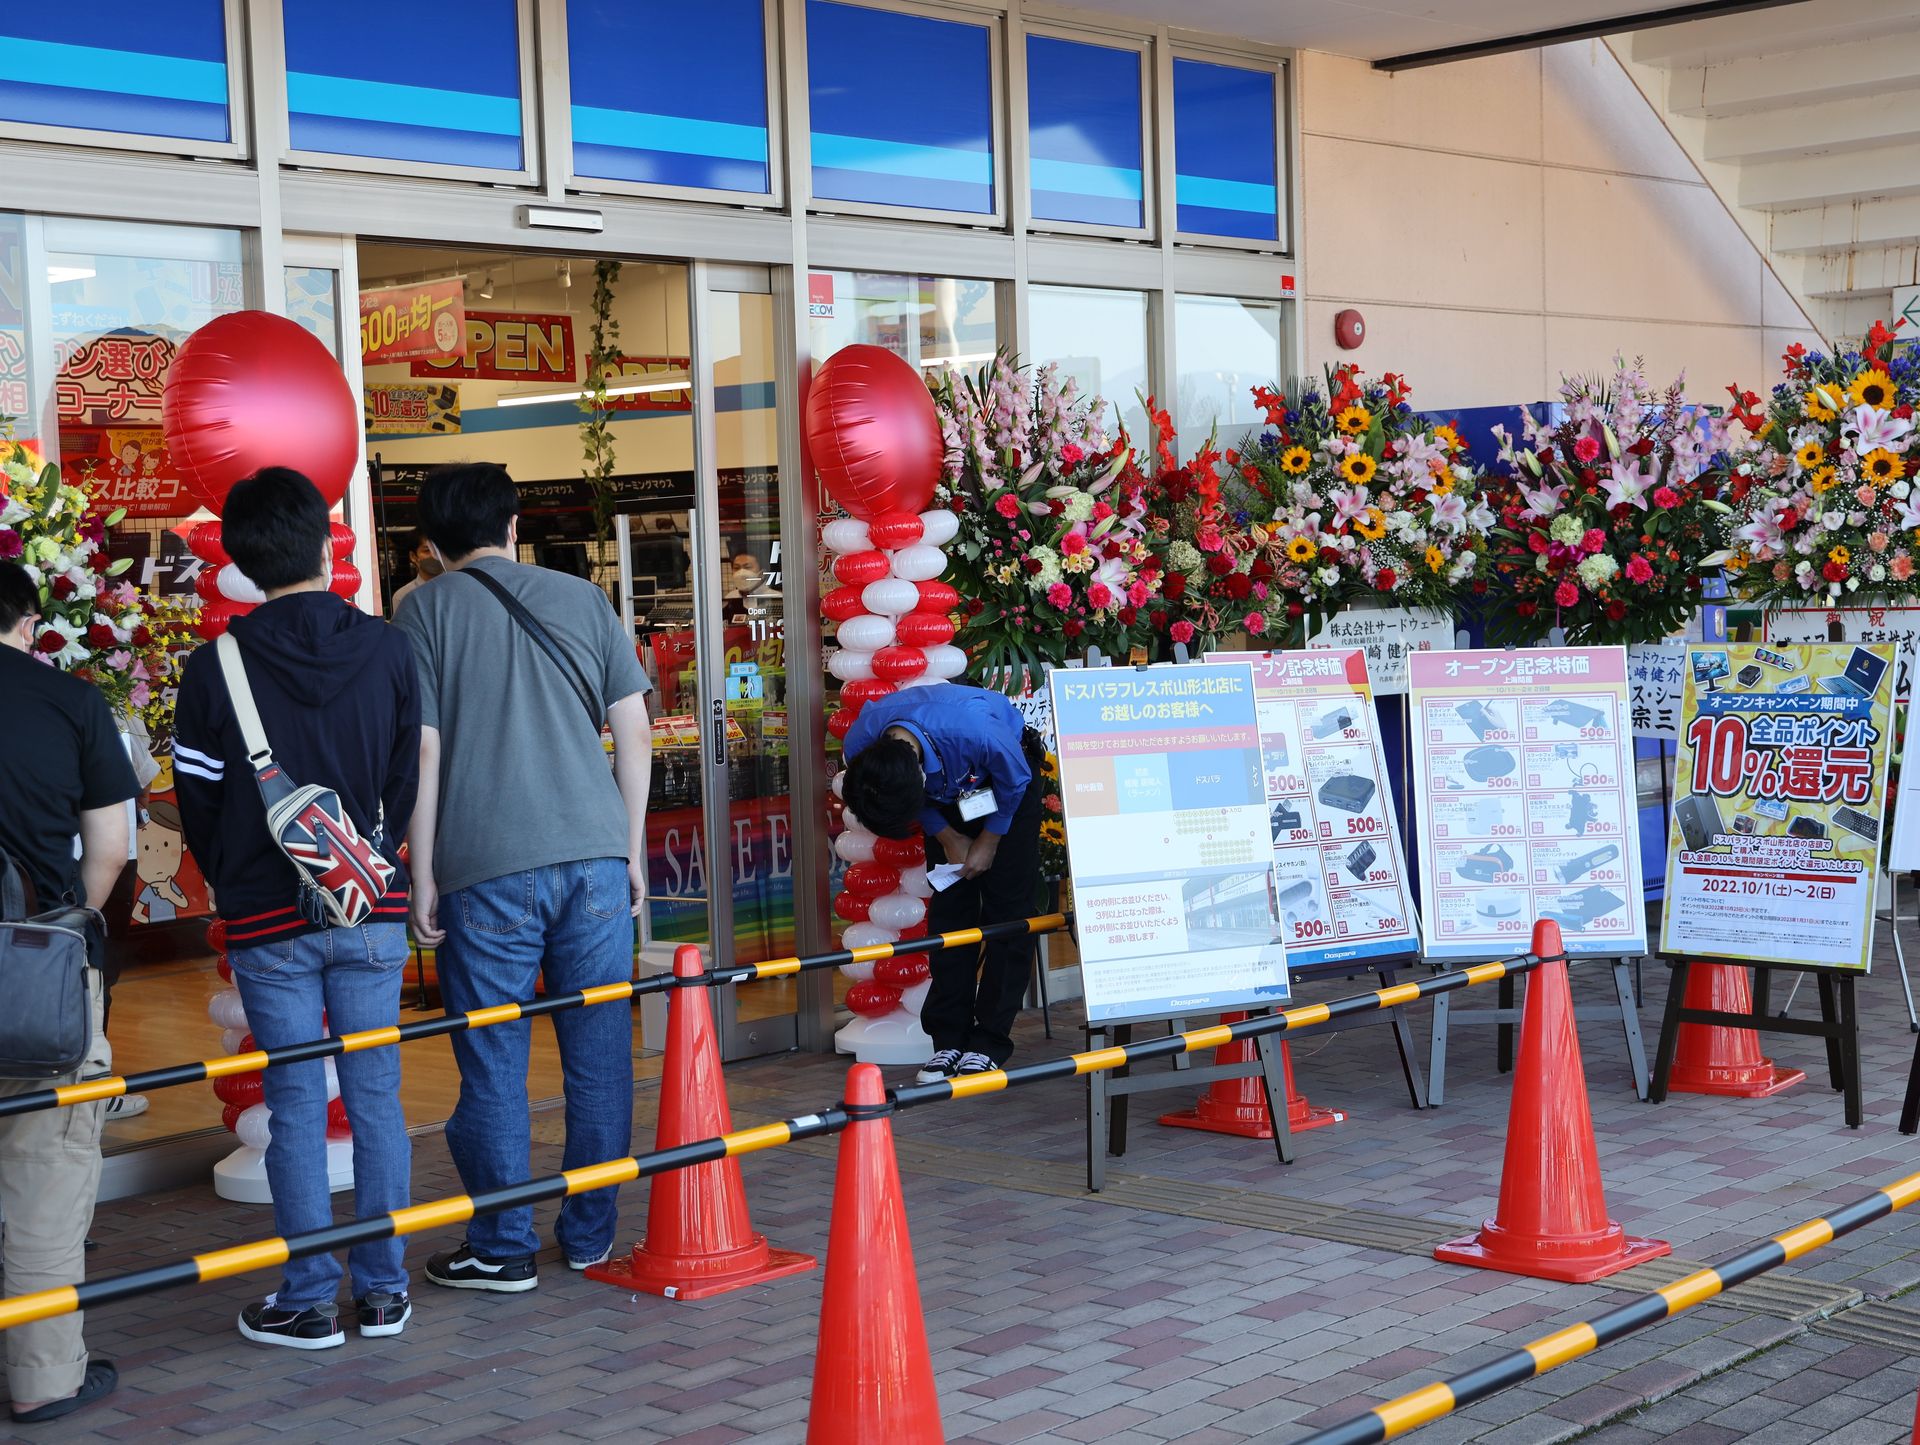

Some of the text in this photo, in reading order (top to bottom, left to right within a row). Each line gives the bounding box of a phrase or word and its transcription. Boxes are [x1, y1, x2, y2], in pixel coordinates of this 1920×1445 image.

[425, 317, 568, 374] PEN
[371, 390, 428, 418] 10%還元
[616, 479, 675, 492] ゲーミングマウス
[748, 608, 767, 616] Open
[1445, 655, 1590, 677] オープン記念特価
[1628, 665, 1681, 684] 崎健介
[1064, 677, 1244, 701] ドスパラフレスポ山形北店に
[1710, 696, 1859, 711] オープンキャンペーン期間中
[1101, 702, 1213, 722] お越しのお客様へ
[1484, 730, 1516, 741] 500円
[1580, 727, 1612, 738] 500円
[1750, 716, 1877, 748] 全品ポイント
[1195, 774, 1221, 785] ドスパラ
[1268, 774, 1305, 792] 500円
[1487, 777, 1519, 788] 500円
[1583, 775, 1615, 785] 500円
[1347, 816, 1384, 834] 500円
[1490, 824, 1522, 835] 500円
[1586, 822, 1618, 833] 500円
[1290, 828, 1314, 841] 500円
[1713, 835, 1831, 850] ドスパラフレスポ山形北店の店頭で
[1732, 847, 1809, 859] ご購入、ご注文を頂くと
[1369, 870, 1393, 882] 500円
[1493, 872, 1525, 883] 500円
[1589, 869, 1622, 880] 500円
[1294, 919, 1331, 938] 500円
[1378, 918, 1401, 930] 500円
[1497, 920, 1528, 931] 500円
[1593, 918, 1625, 928] 500円
[1324, 951, 1356, 960] Dospara
